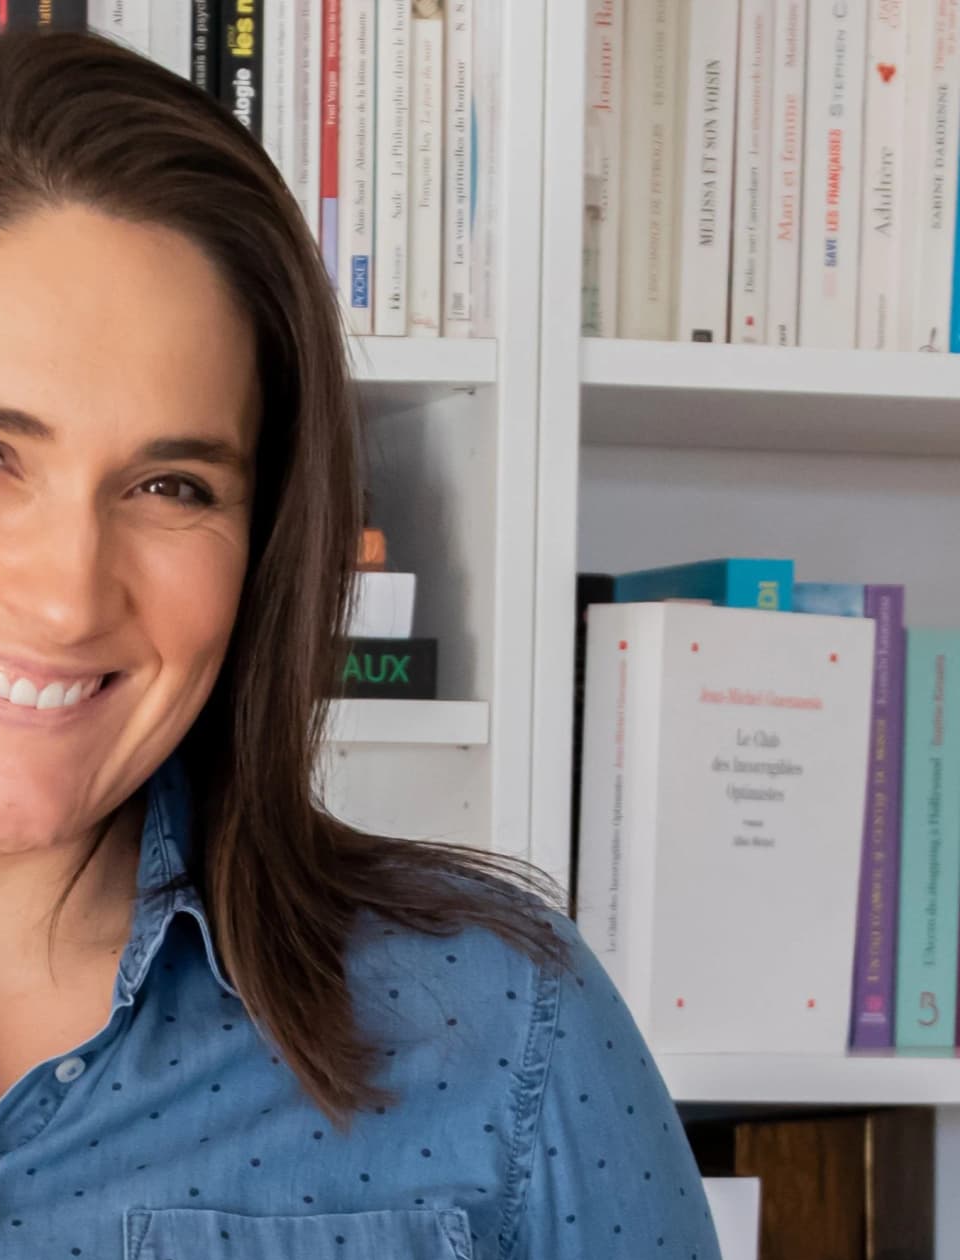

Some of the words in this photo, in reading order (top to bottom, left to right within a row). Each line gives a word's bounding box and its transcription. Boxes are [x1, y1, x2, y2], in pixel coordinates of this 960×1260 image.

[230, 17, 254, 57] les
[232, 67, 256, 127] ologie
[703, 59, 721, 114] VOISIN
[702, 118, 719, 150] SON
[826, 128, 845, 206] FRANÇAISES
[825, 210, 840, 232] LES
[343, 654, 411, 684] AUX
